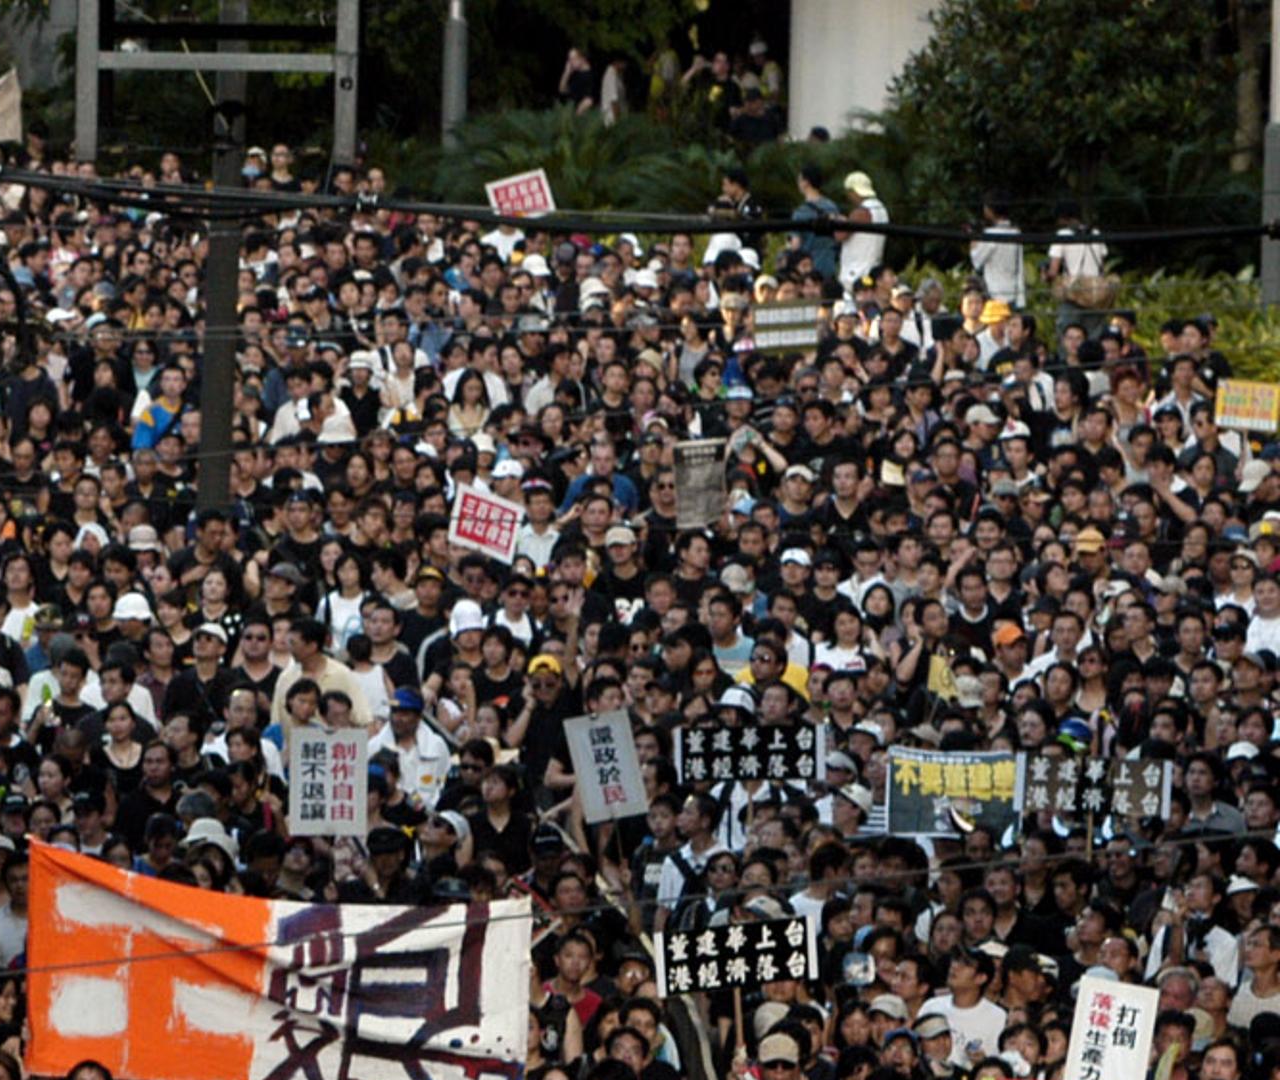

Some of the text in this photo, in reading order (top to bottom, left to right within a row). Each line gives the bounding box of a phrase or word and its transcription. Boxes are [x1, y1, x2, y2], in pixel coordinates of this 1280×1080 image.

[685, 728, 816, 754] 董建華上台
[331, 742, 358, 821] 創作自由
[685, 754, 816, 780] 港經濟落台
[668, 920, 804, 961] 董建華上台
[669, 951, 807, 992] 港經濟落台
[1113, 1006, 1140, 1050] 打倒
